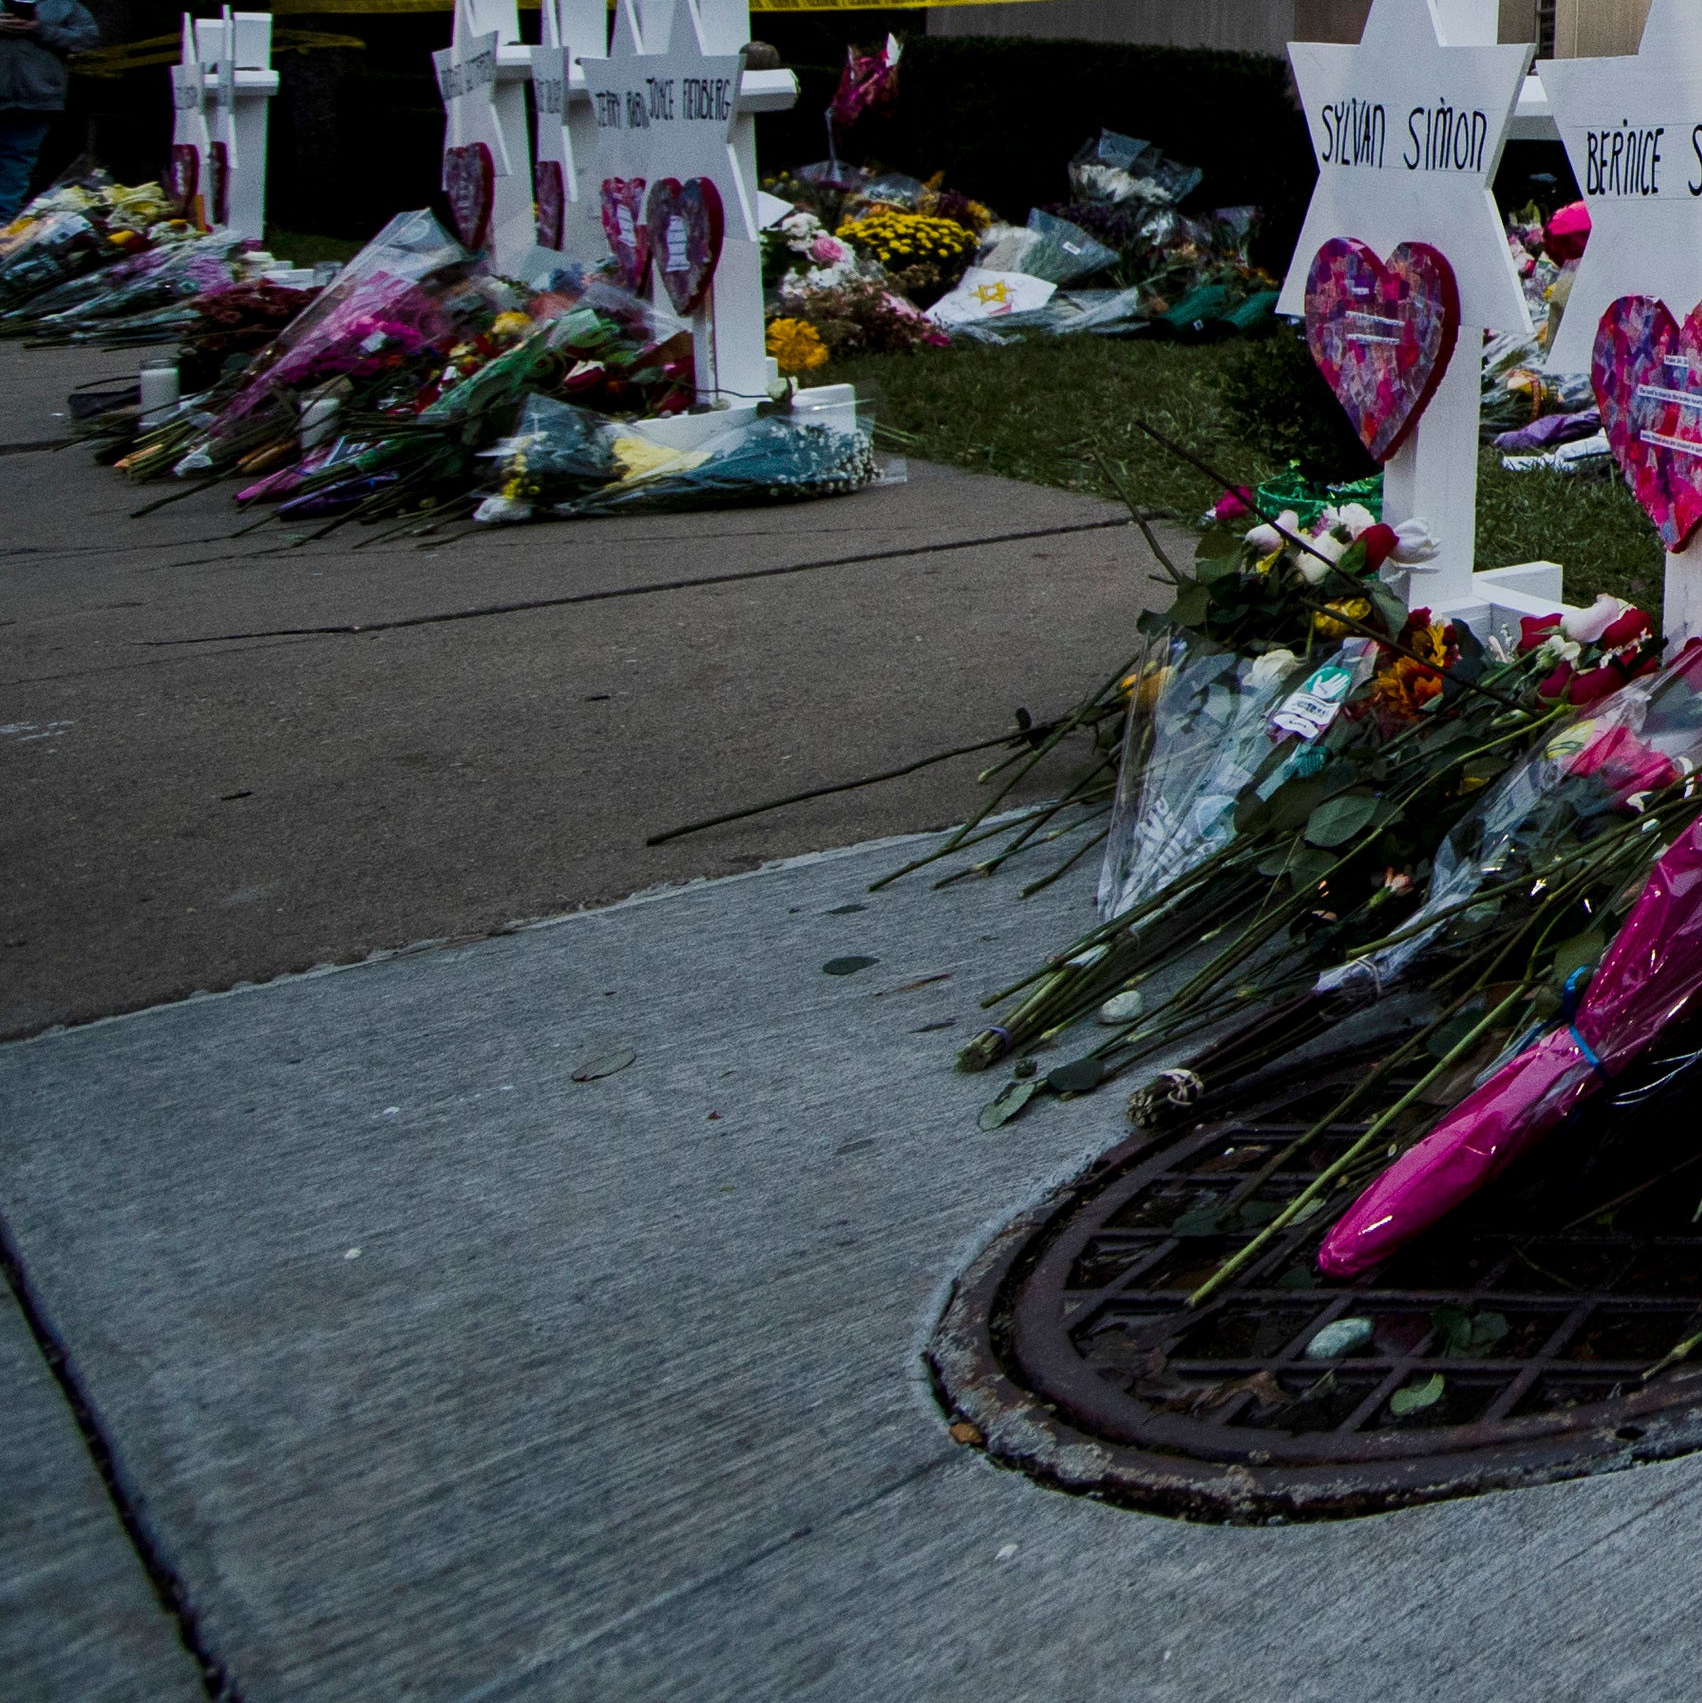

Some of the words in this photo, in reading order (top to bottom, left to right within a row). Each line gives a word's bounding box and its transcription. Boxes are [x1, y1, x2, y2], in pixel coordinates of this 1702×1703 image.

[1321, 99, 1386, 169] SYLVAN
[1404, 105, 1488, 171] SIMON
[1587, 126, 1665, 196] BERNICE
